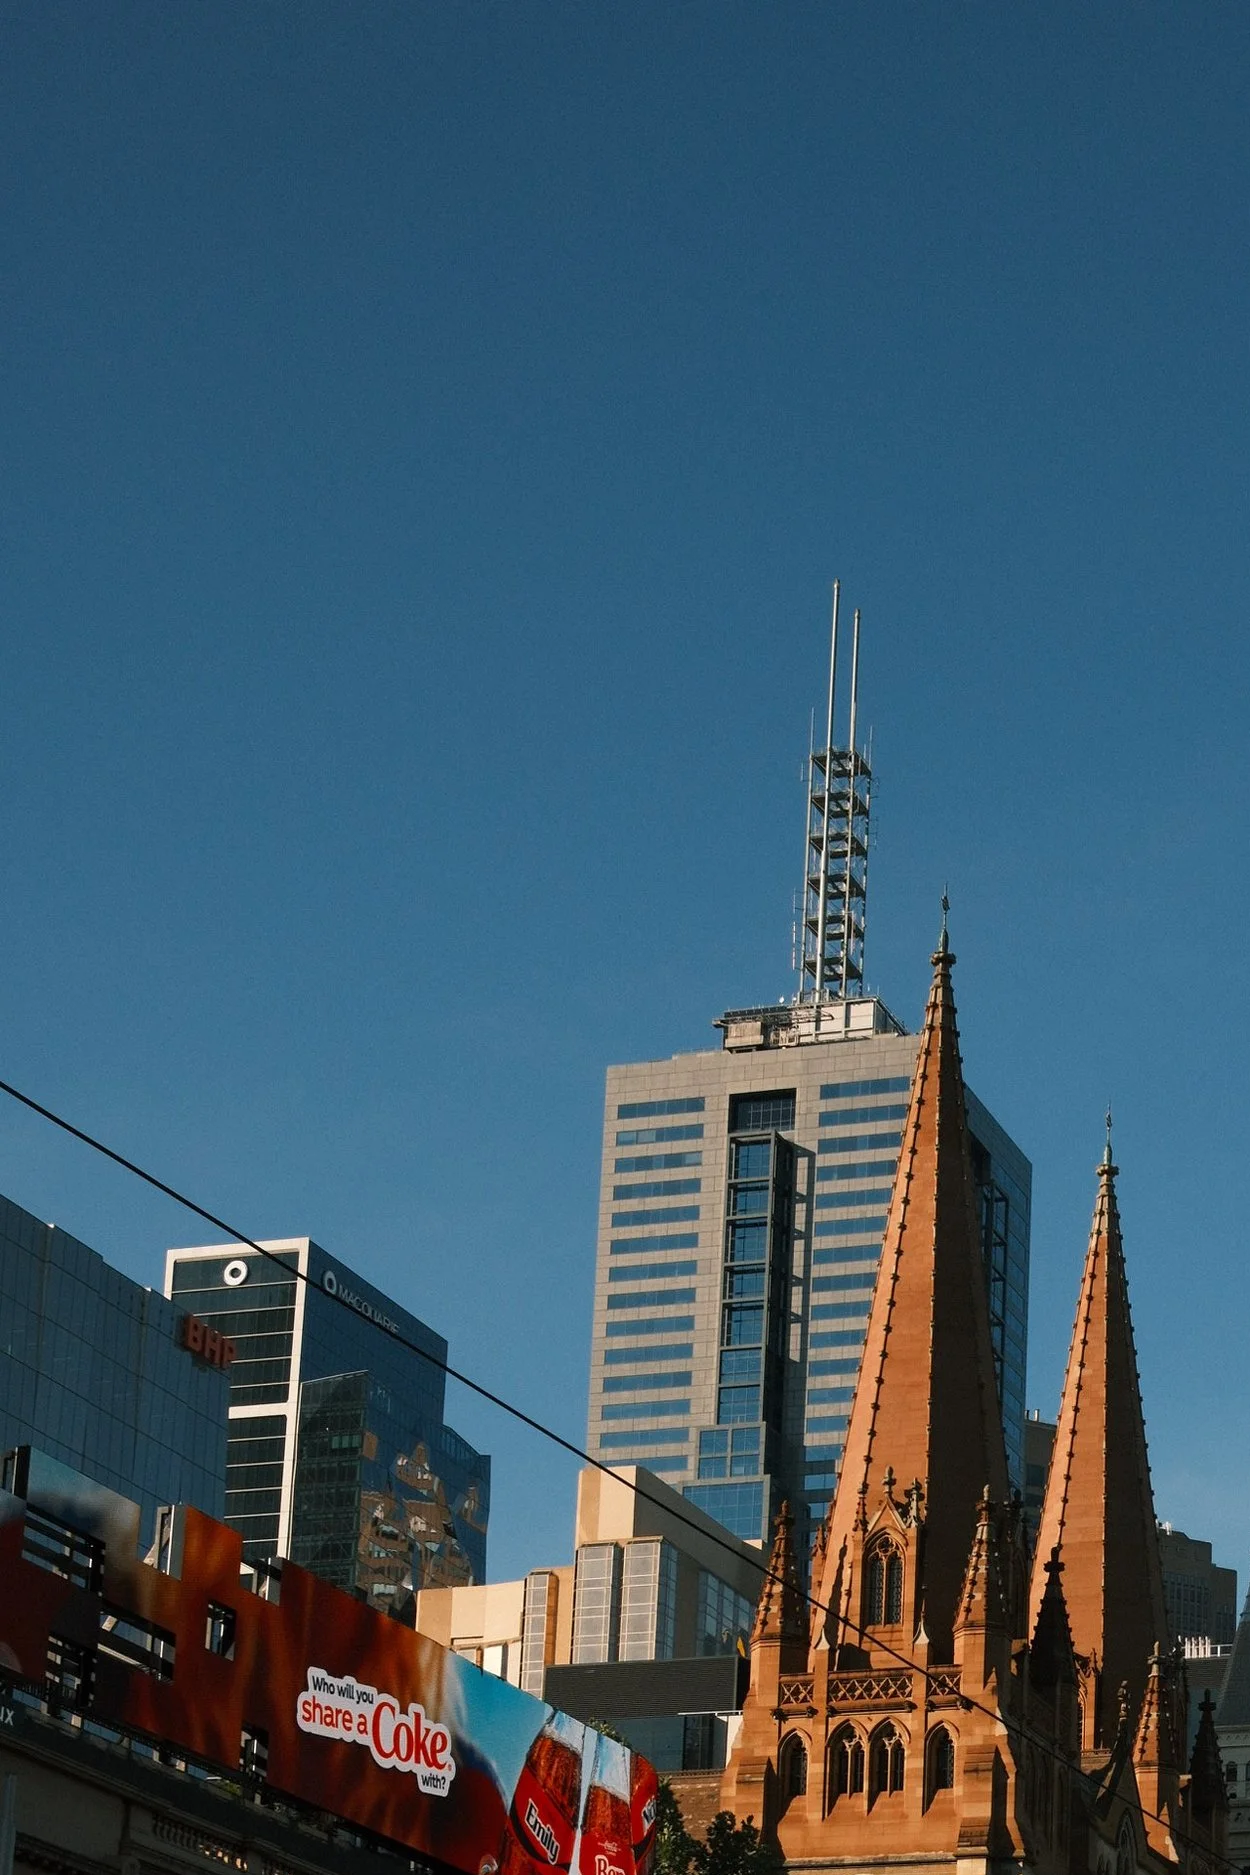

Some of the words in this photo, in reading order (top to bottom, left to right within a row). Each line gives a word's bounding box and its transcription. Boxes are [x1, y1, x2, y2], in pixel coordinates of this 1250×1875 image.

[338, 1284, 401, 1334] MACQUARIE
[184, 1314, 237, 1370] BHP
[312, 1675, 335, 1695] Who
[336, 1683, 355, 1701] will
[356, 1690, 374, 1705] you
[301, 1695, 353, 1732] share
[357, 1713, 368, 1735] a
[372, 1701, 448, 1771] Coke
[421, 1773, 447, 1790] with?
[526, 1803, 560, 1863] Emily
